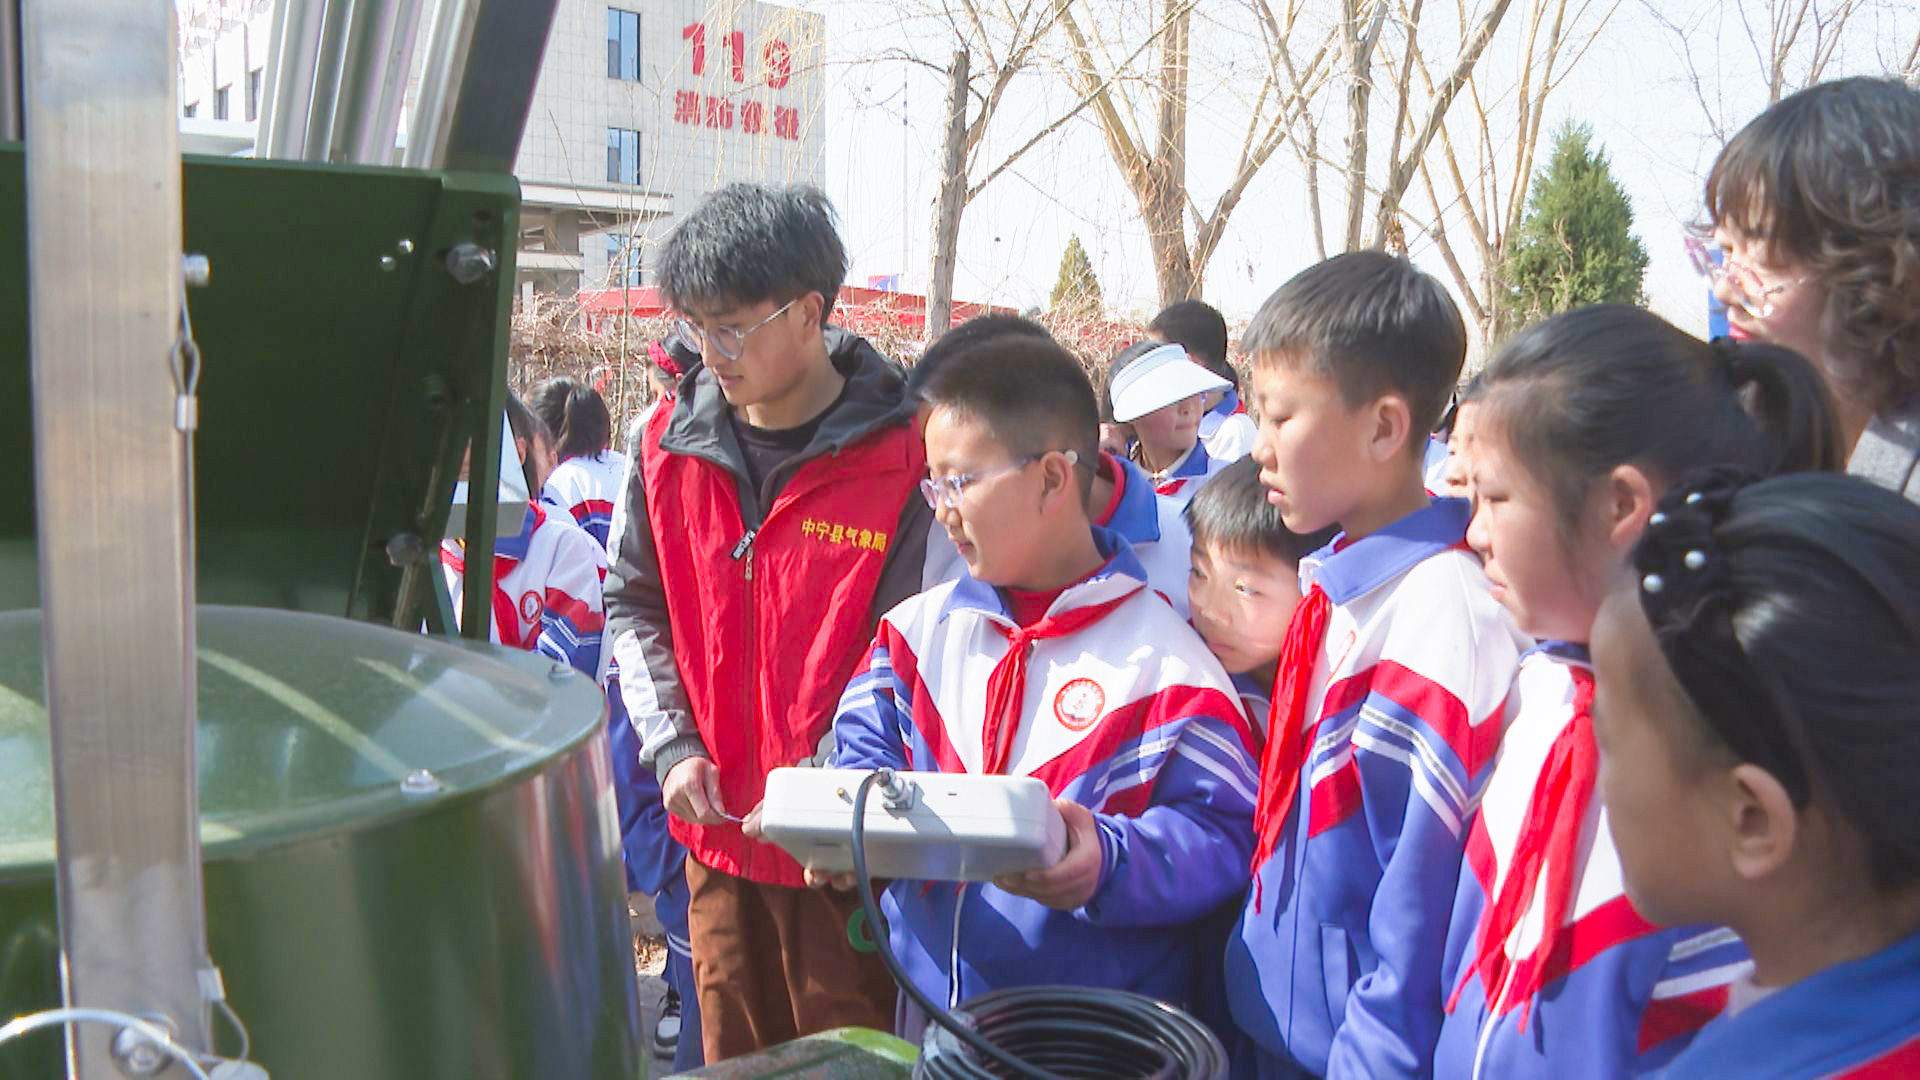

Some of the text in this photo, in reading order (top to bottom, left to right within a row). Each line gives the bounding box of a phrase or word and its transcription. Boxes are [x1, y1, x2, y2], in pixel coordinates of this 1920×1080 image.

[682, 22, 791, 90] 119
[801, 516, 887, 552] 中宁县气象局
